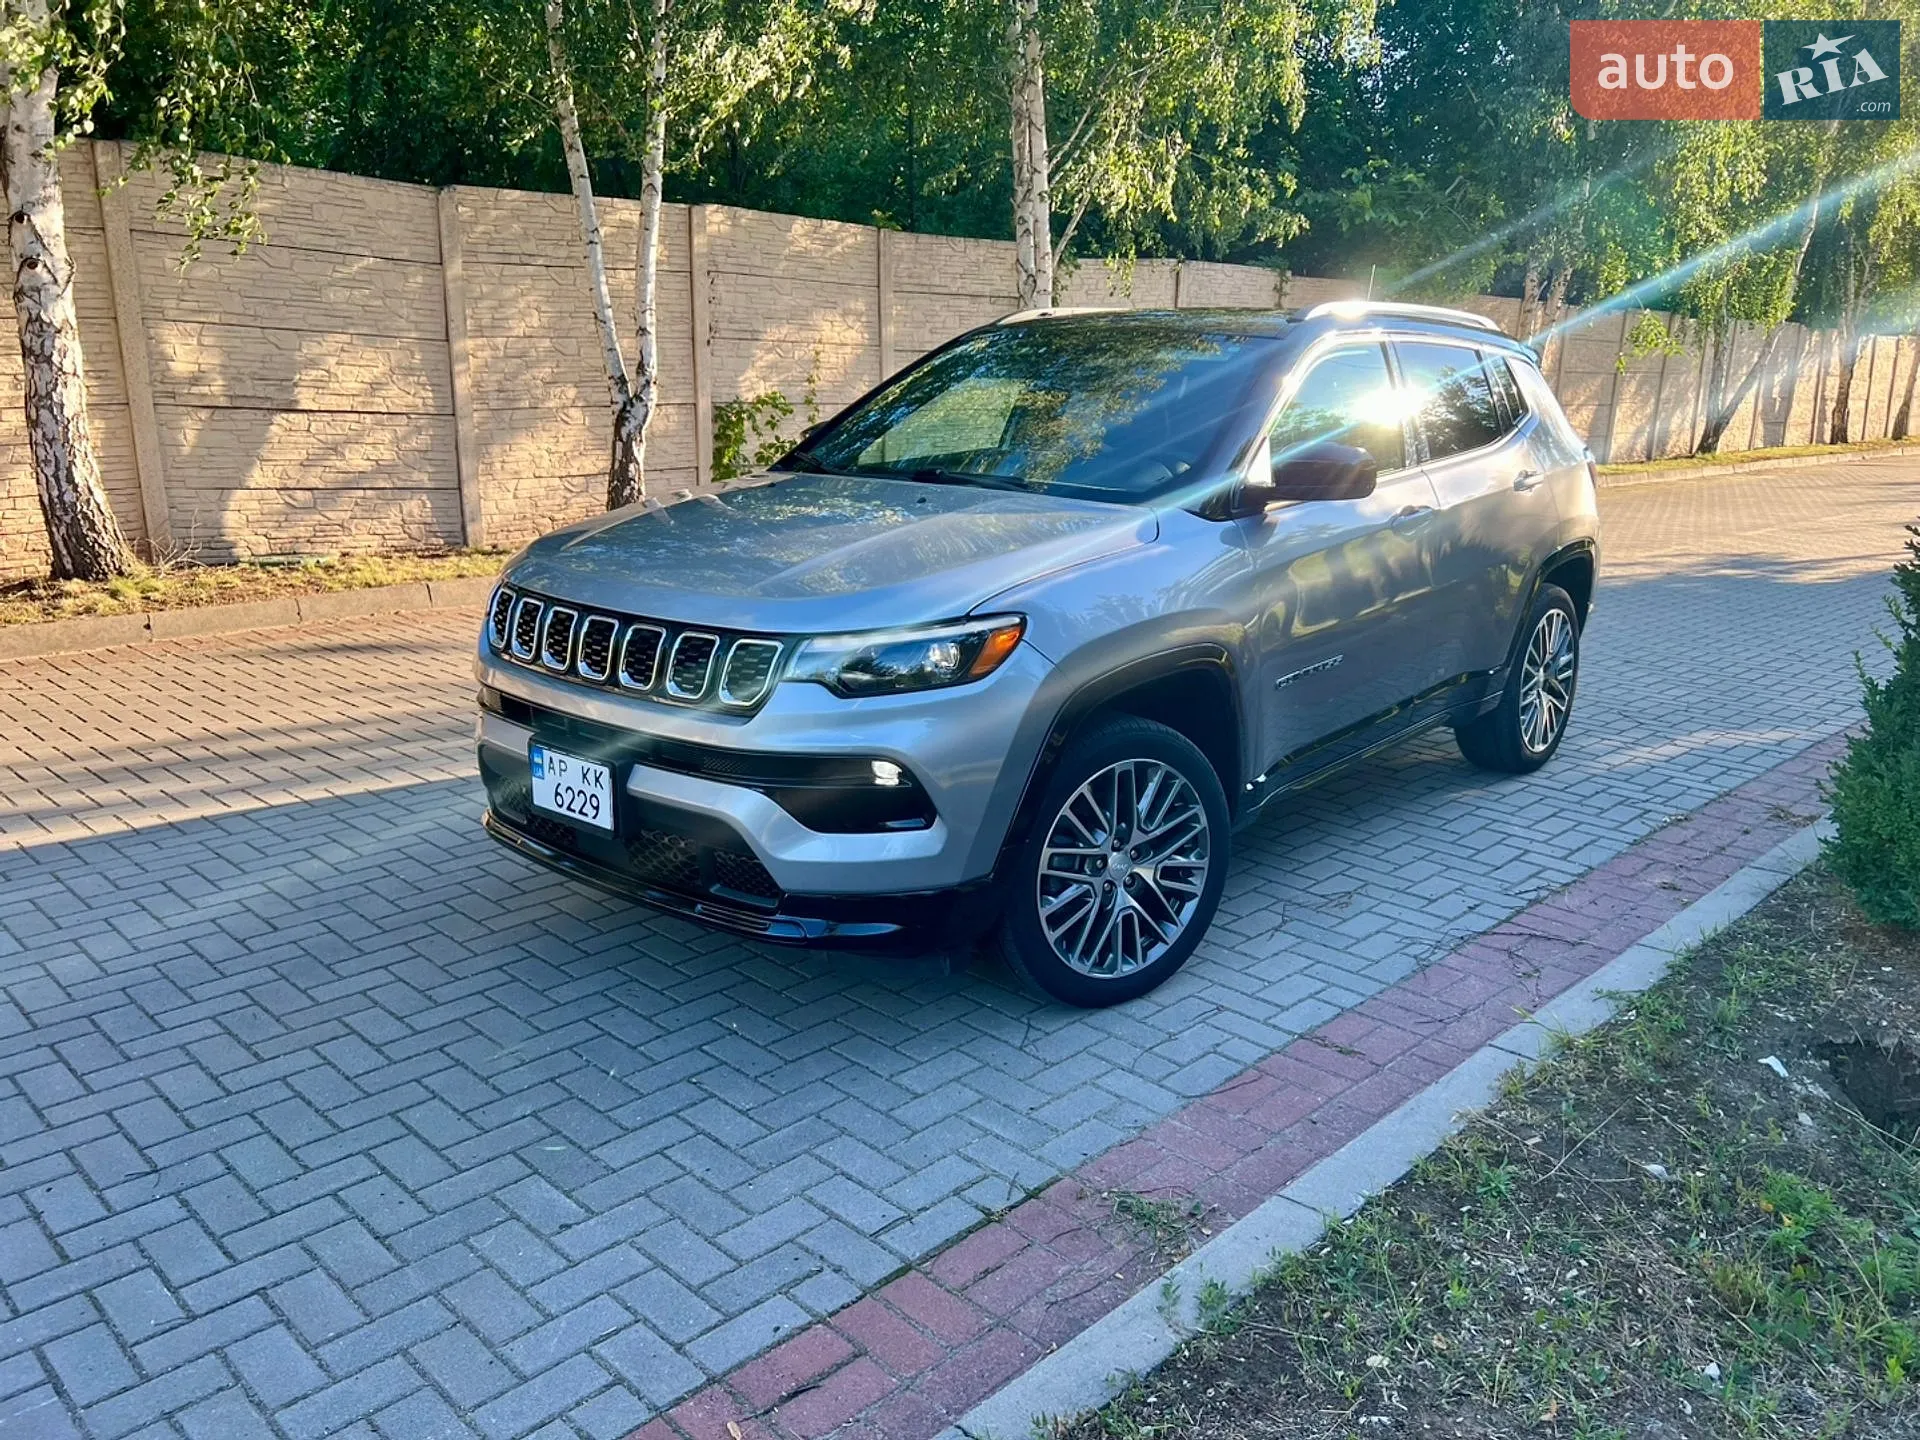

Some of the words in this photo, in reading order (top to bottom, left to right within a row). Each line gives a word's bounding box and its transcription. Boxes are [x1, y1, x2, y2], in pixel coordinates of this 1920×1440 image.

[548, 756, 568, 777] AP
[581, 765, 604, 790] KK
[554, 782, 600, 820] 6229
